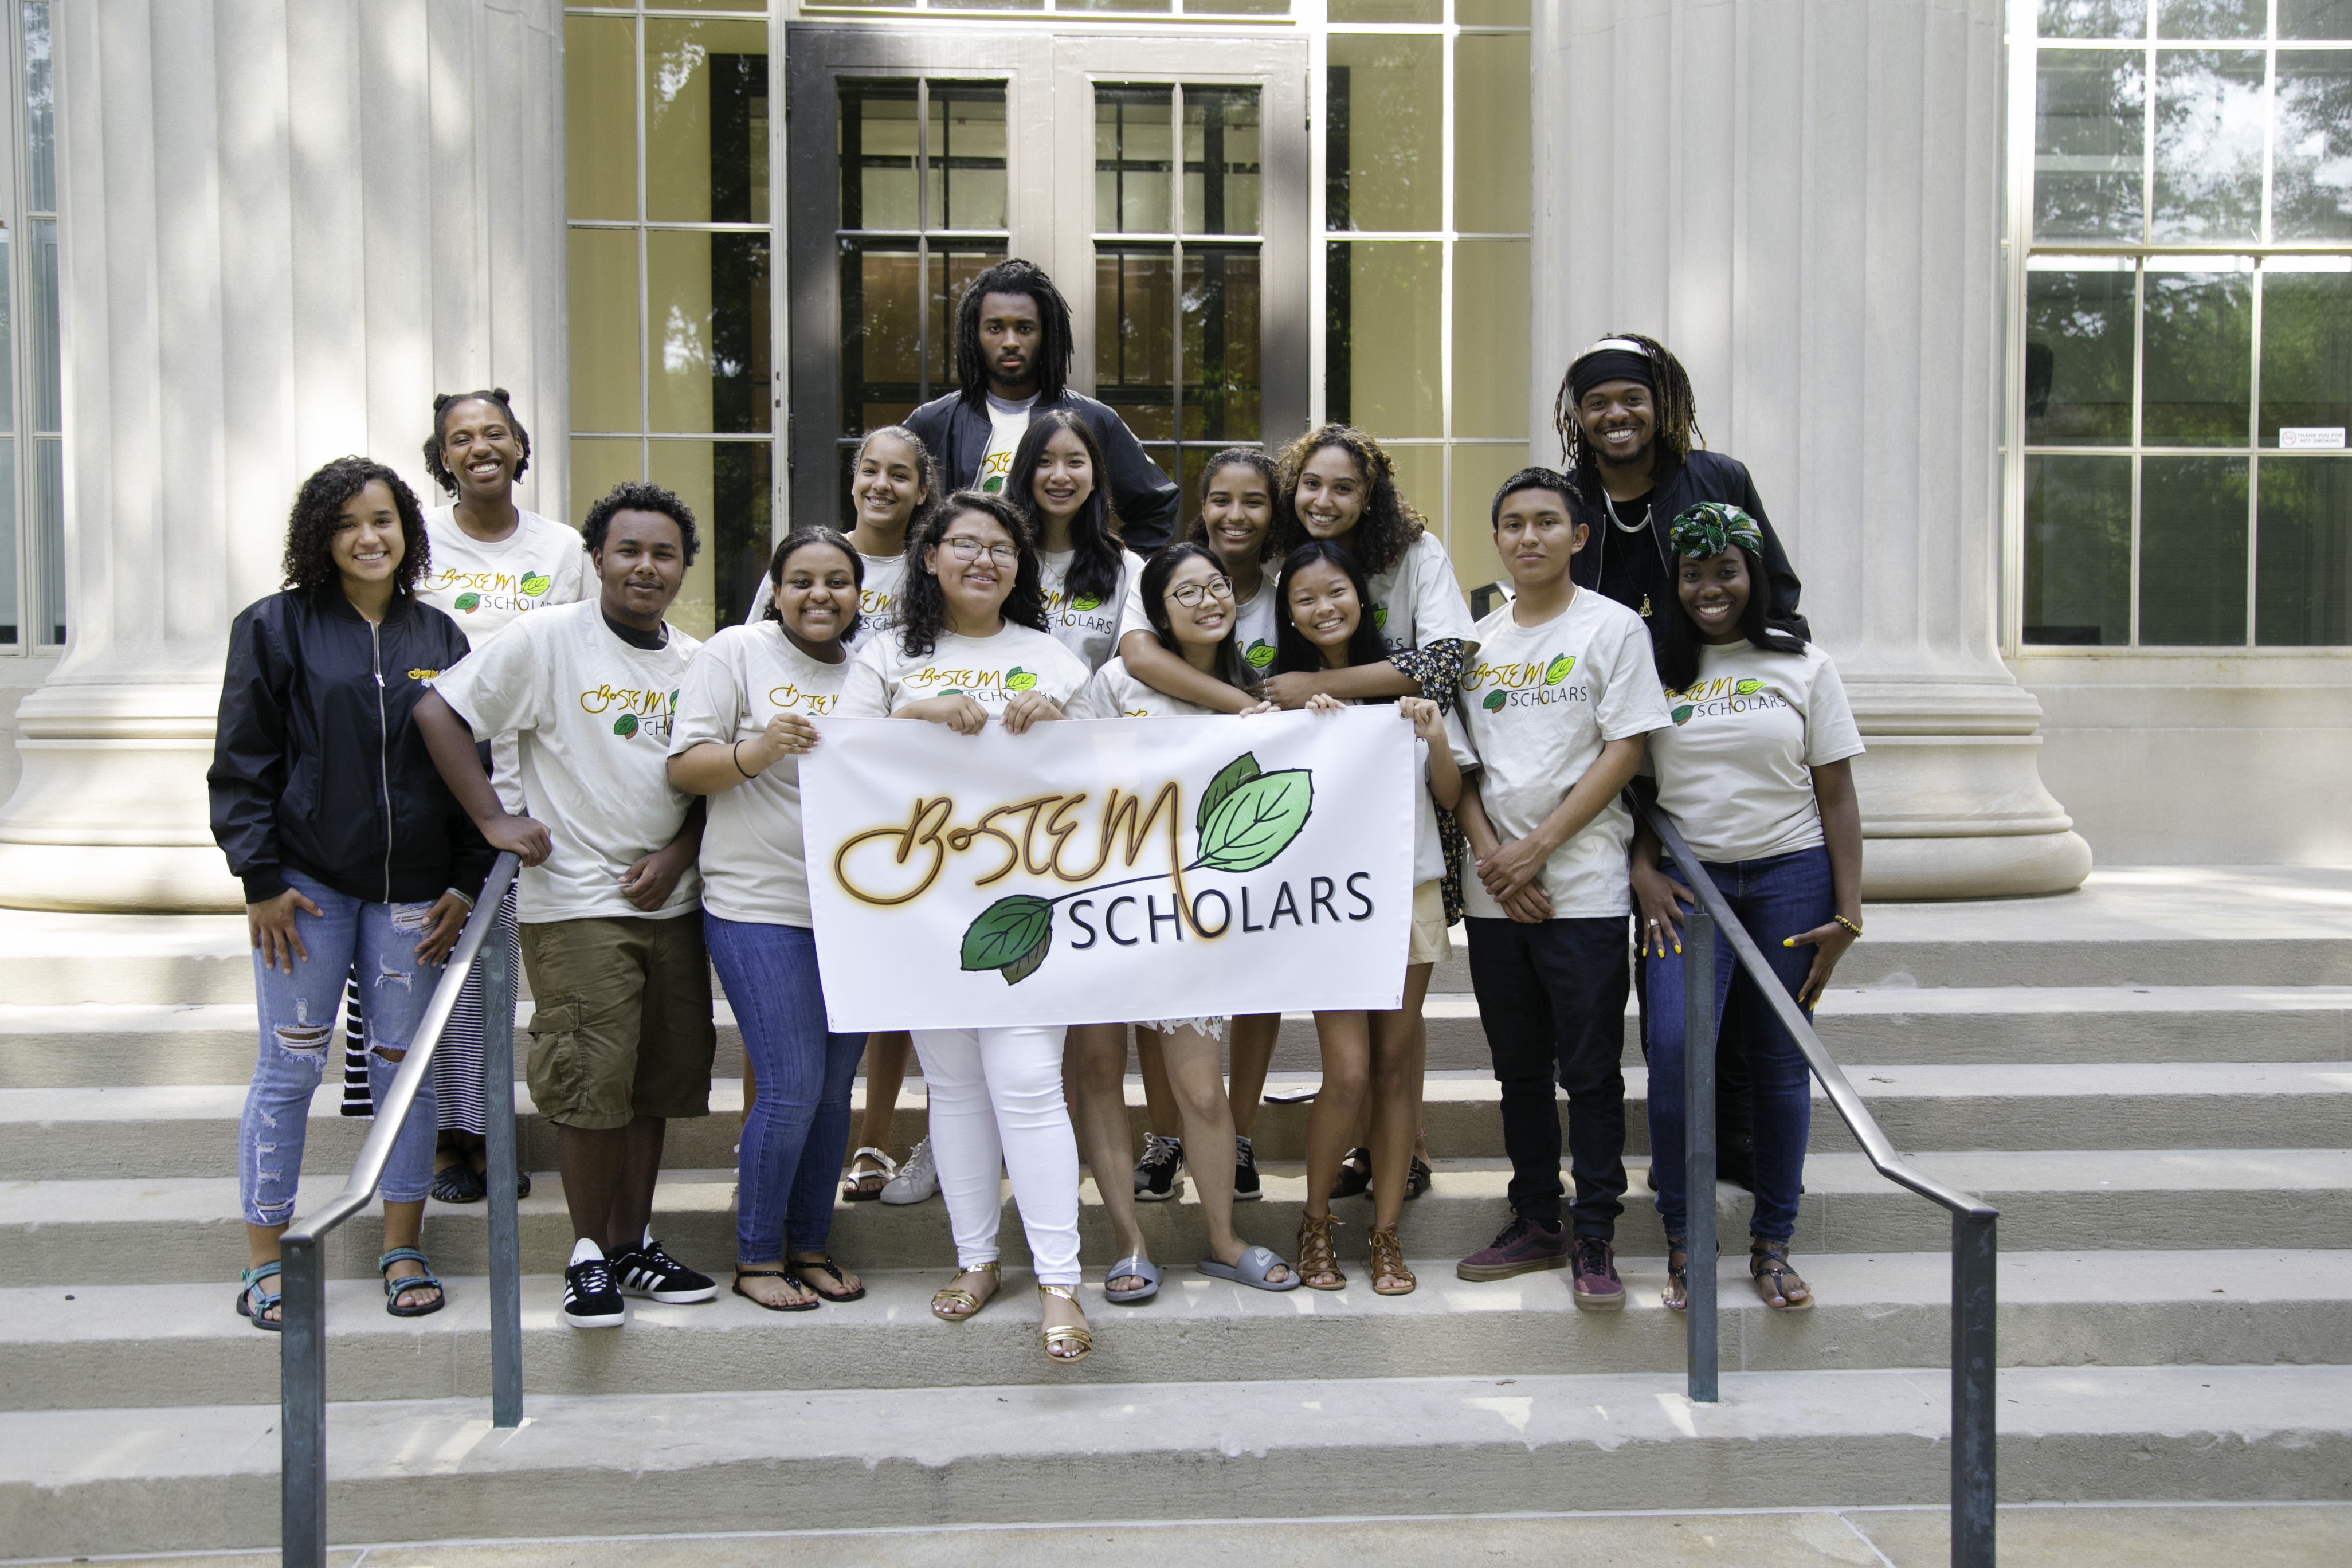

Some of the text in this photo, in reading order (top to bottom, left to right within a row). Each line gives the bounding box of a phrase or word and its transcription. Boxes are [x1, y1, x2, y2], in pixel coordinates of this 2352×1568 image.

[1511, 687, 1587, 706] SCHOLARS
[1697, 695, 1787, 718] SCHOLARS
[1068, 871, 1374, 949] SCHOLARS
